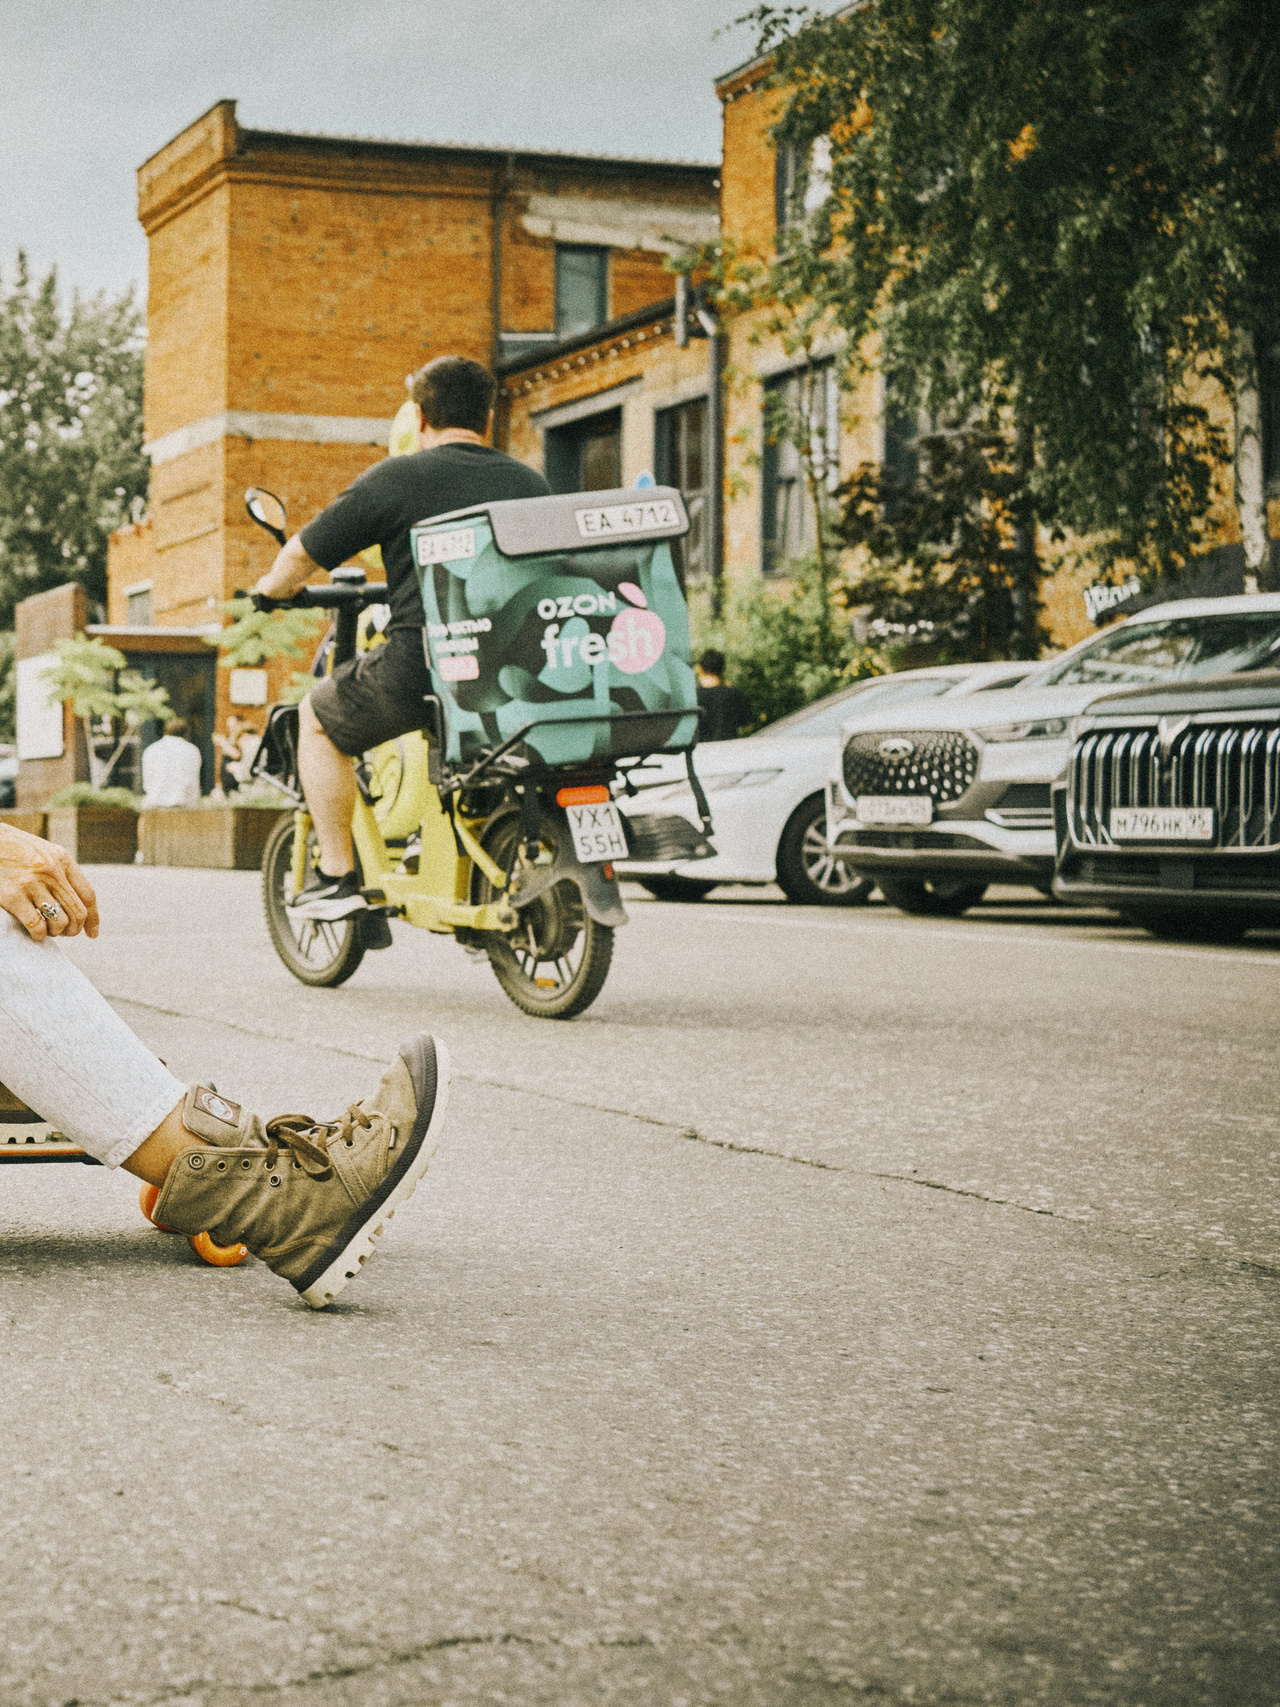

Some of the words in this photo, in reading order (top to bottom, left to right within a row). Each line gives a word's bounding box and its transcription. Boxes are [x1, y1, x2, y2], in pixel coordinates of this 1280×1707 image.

[622, 505, 672, 528] 4712
[537, 591, 617, 620] OZON
[540, 616, 653, 669] fresh
